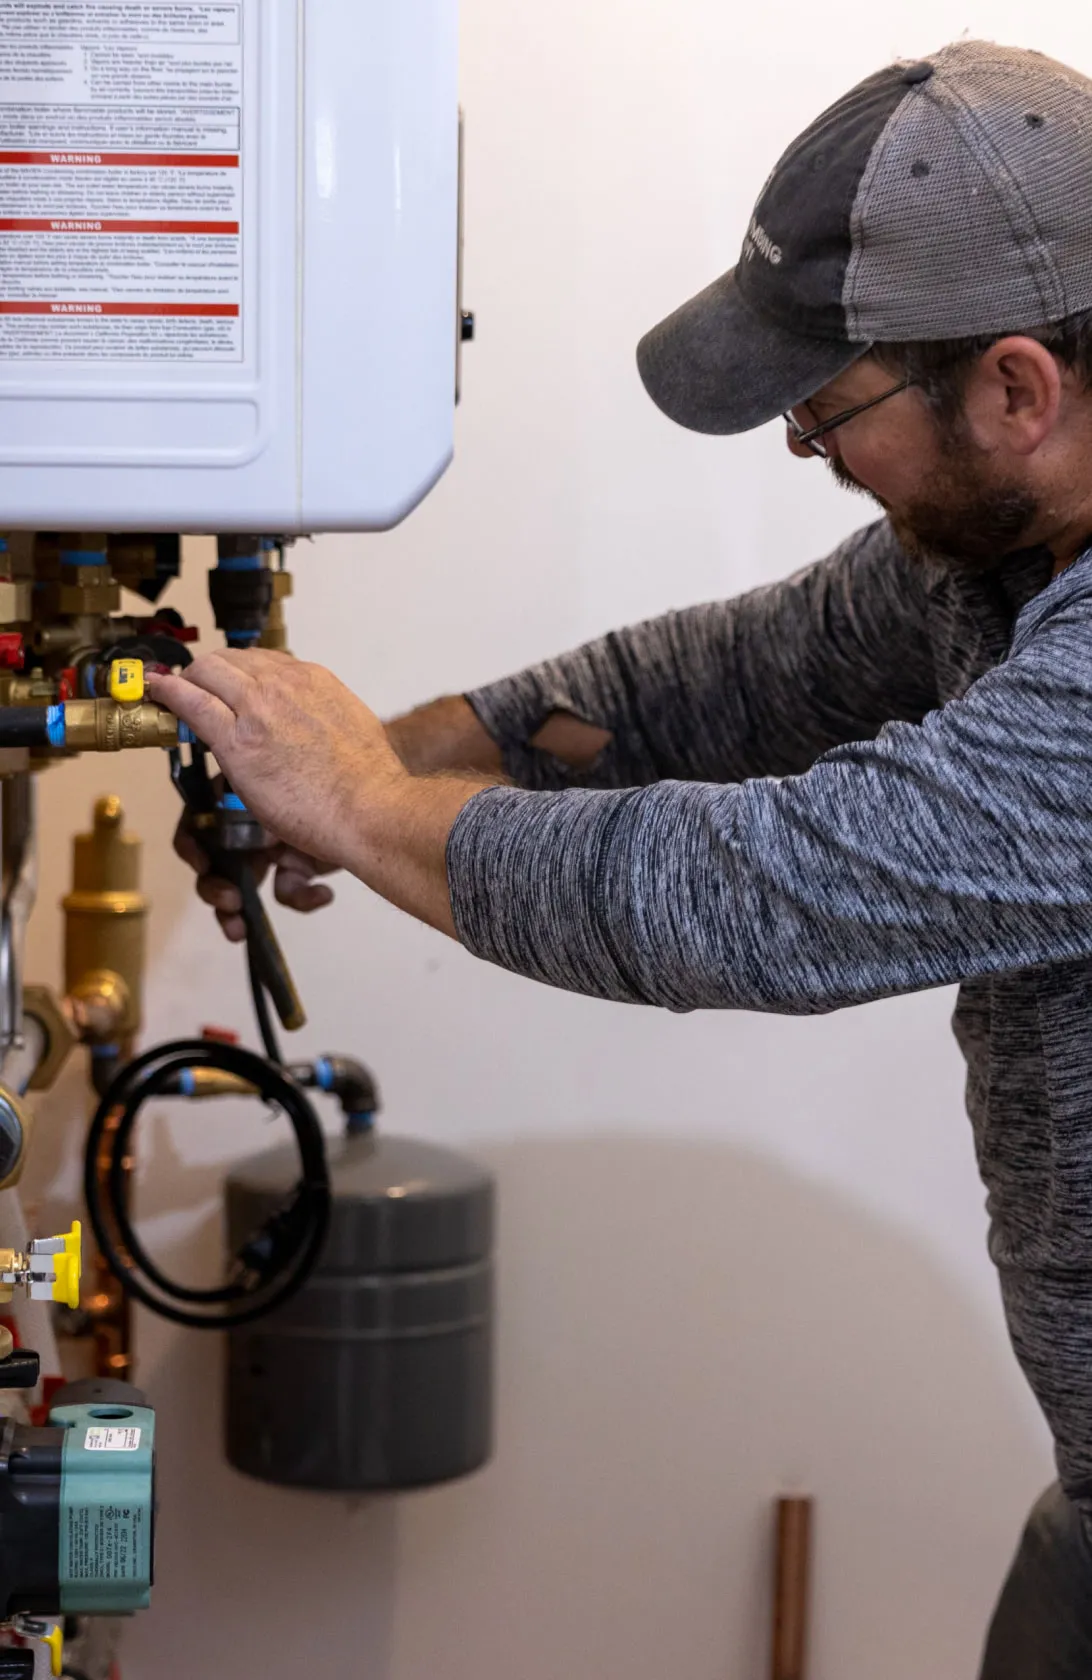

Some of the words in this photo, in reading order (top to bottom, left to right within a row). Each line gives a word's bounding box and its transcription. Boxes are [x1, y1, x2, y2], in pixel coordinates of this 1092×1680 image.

[50, 154, 102, 163] WARNING
[51, 221, 102, 230] WARNING
[51, 304, 102, 313] WARNING
